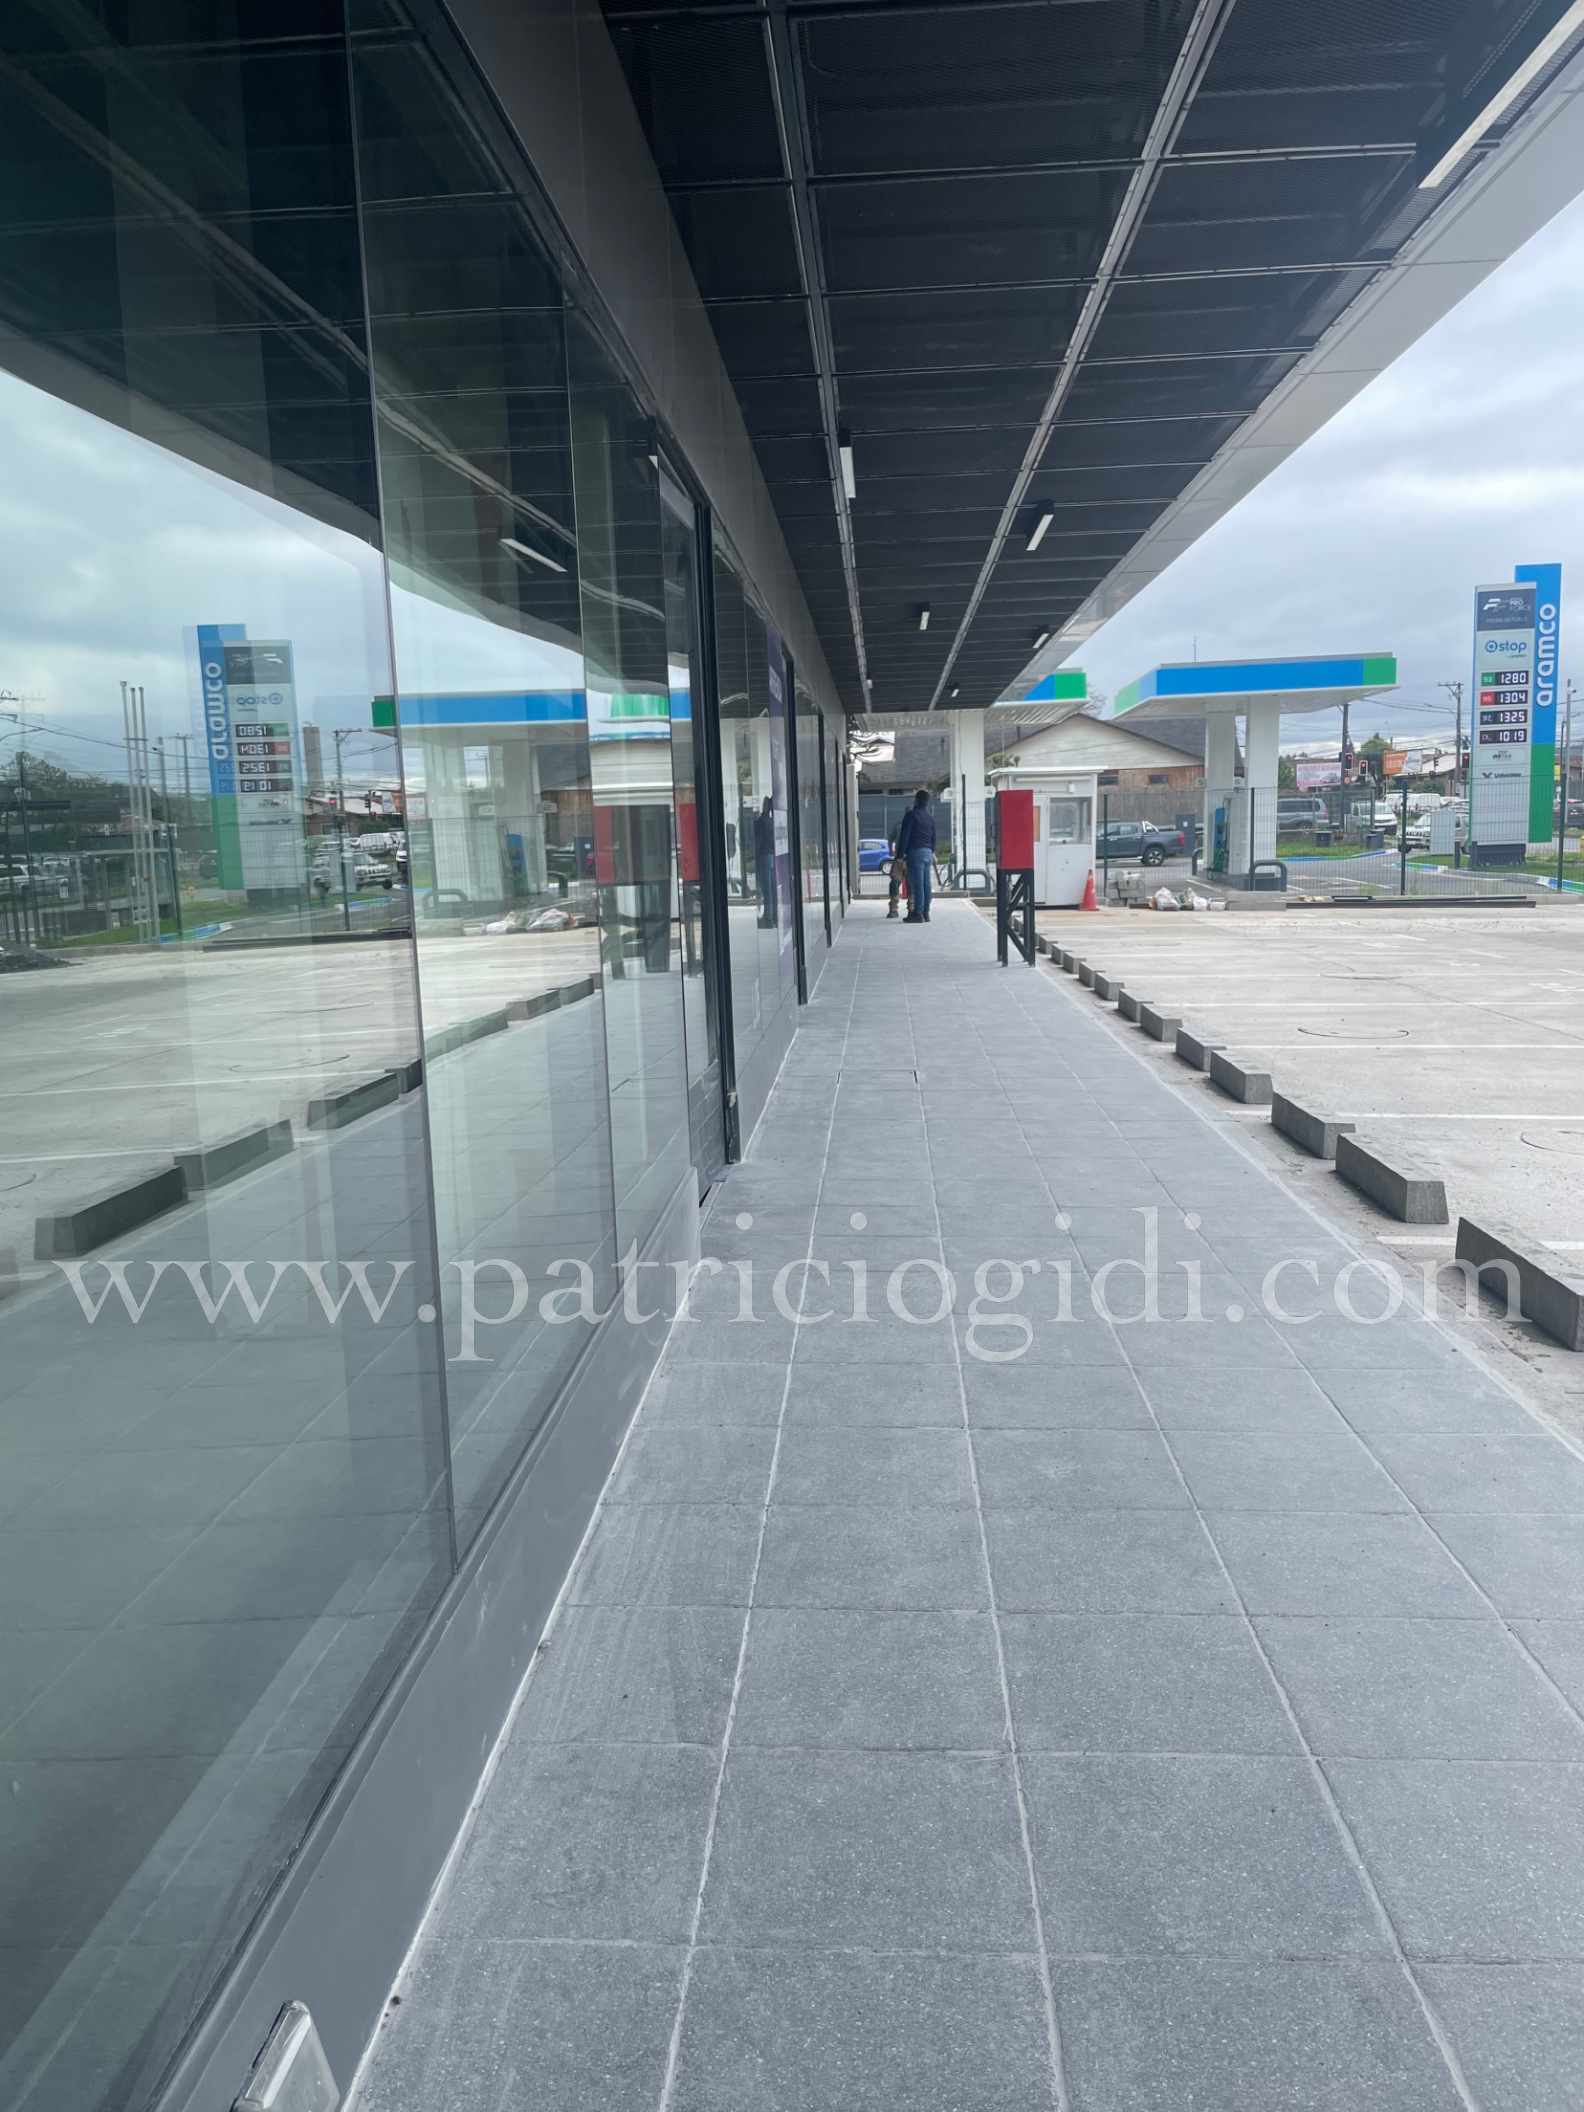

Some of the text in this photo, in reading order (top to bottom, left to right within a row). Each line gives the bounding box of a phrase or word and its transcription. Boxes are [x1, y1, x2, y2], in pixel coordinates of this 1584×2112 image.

[1536, 603, 1556, 707] aramco
[1501, 672, 1526, 684] 1280
[1500, 692, 1526, 703] 1304
[1500, 711, 1525, 722] 1325
[1499, 730, 1524, 742] 1019
